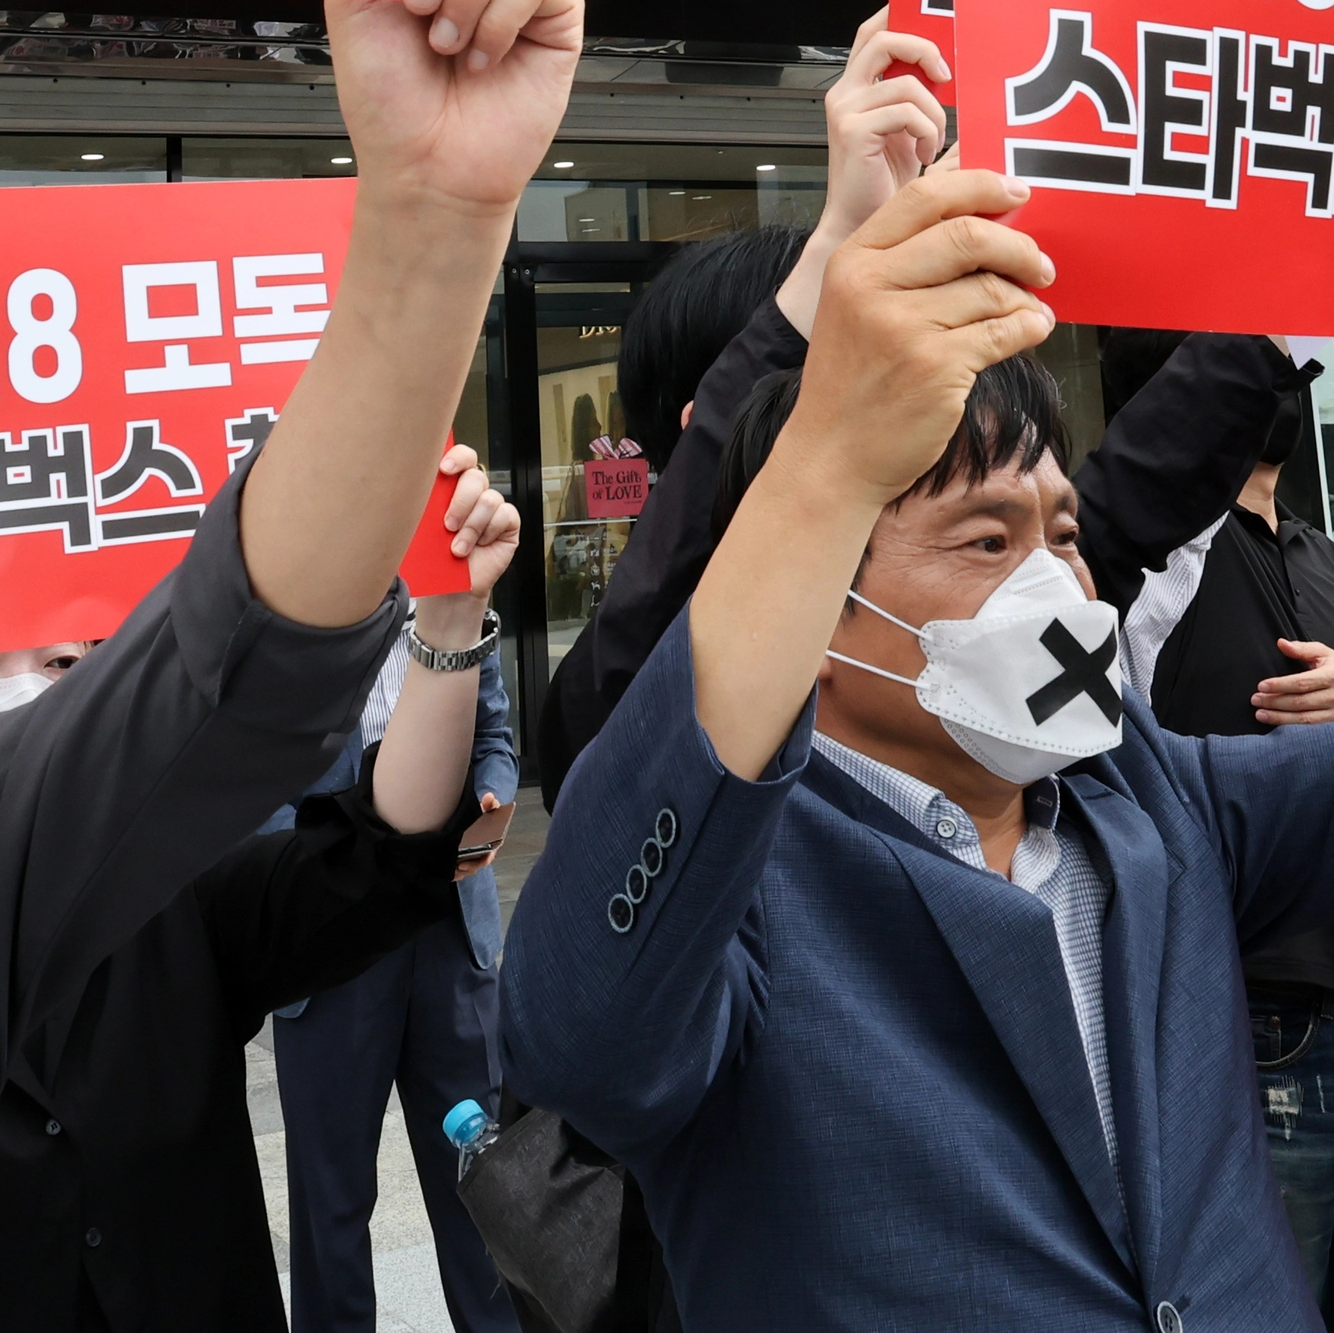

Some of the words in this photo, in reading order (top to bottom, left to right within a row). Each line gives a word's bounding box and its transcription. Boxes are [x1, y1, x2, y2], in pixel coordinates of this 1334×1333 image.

[122, 252, 331, 394] 모독
[592, 470, 614, 485] The
[616, 469, 642, 484] Gift
[592, 487, 604, 500] of
[605, 485, 642, 501] LOVE
